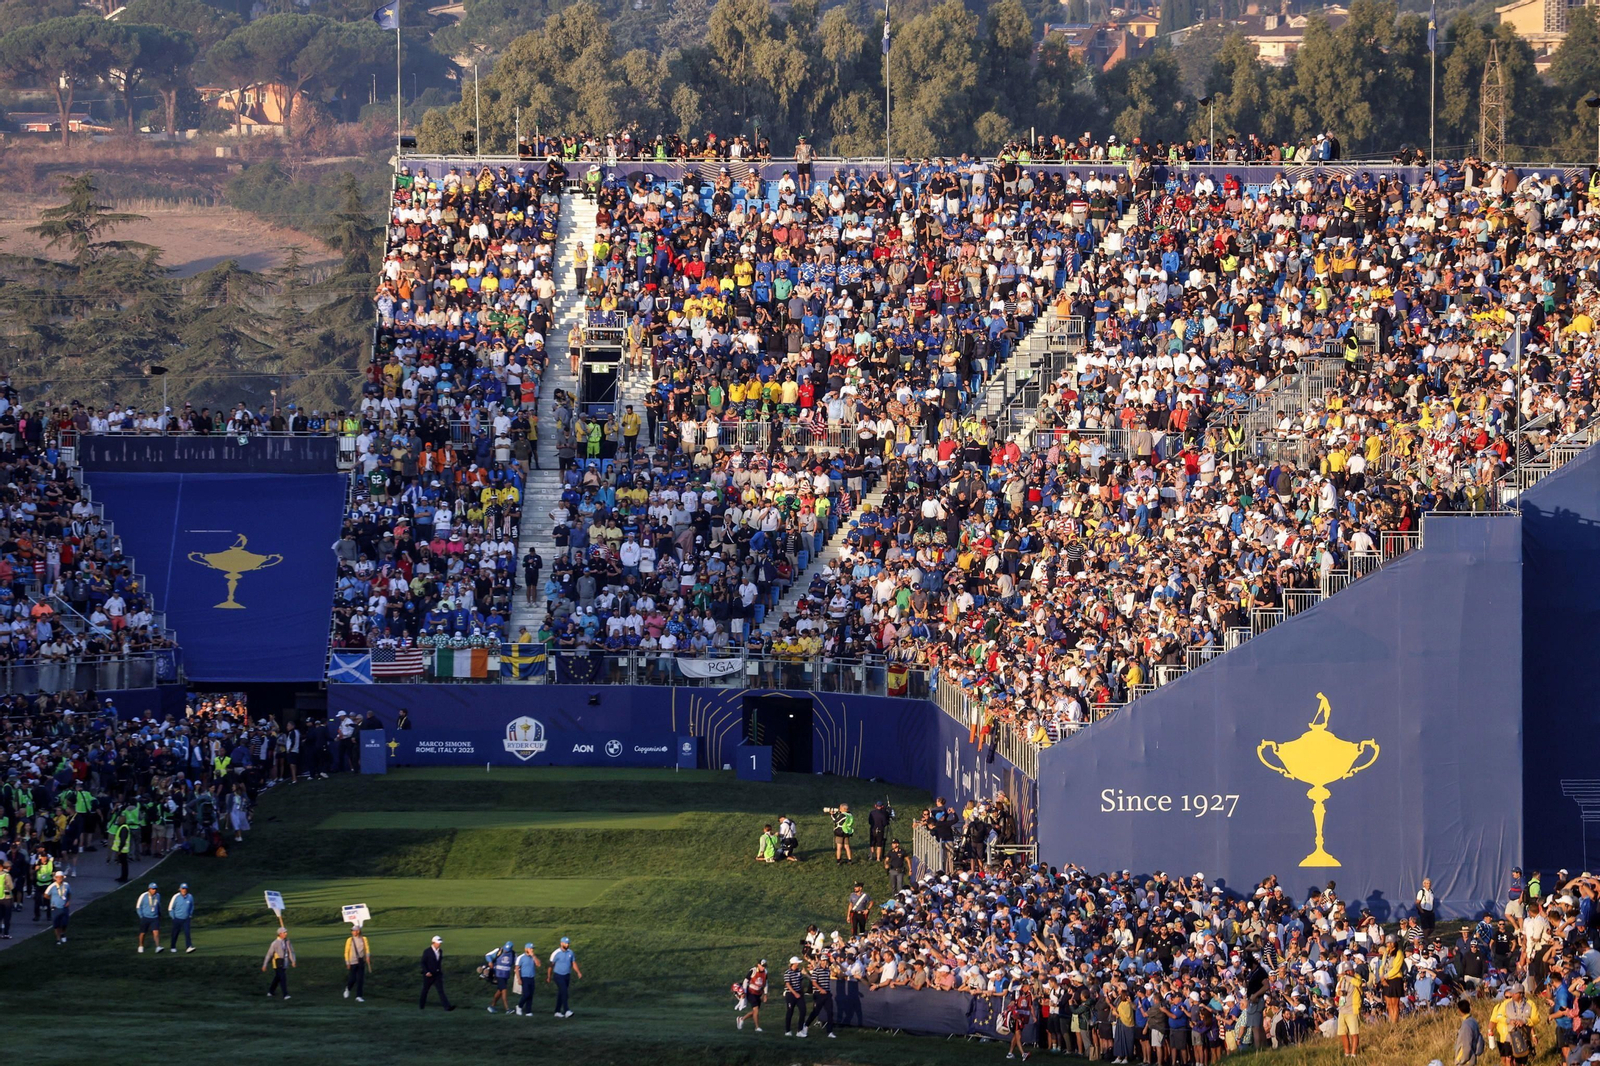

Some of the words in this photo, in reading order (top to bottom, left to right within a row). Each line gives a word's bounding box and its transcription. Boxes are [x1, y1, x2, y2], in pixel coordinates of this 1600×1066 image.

[371, 475, 382, 484] 62
[707, 661, 735, 672] PGA
[572, 744, 594, 753] AON
[634, 745, 662, 754] Capgemini
[750, 754, 756, 770] 1
[1101, 788, 1172, 812] Since
[1181, 794, 1240, 818] 1927
